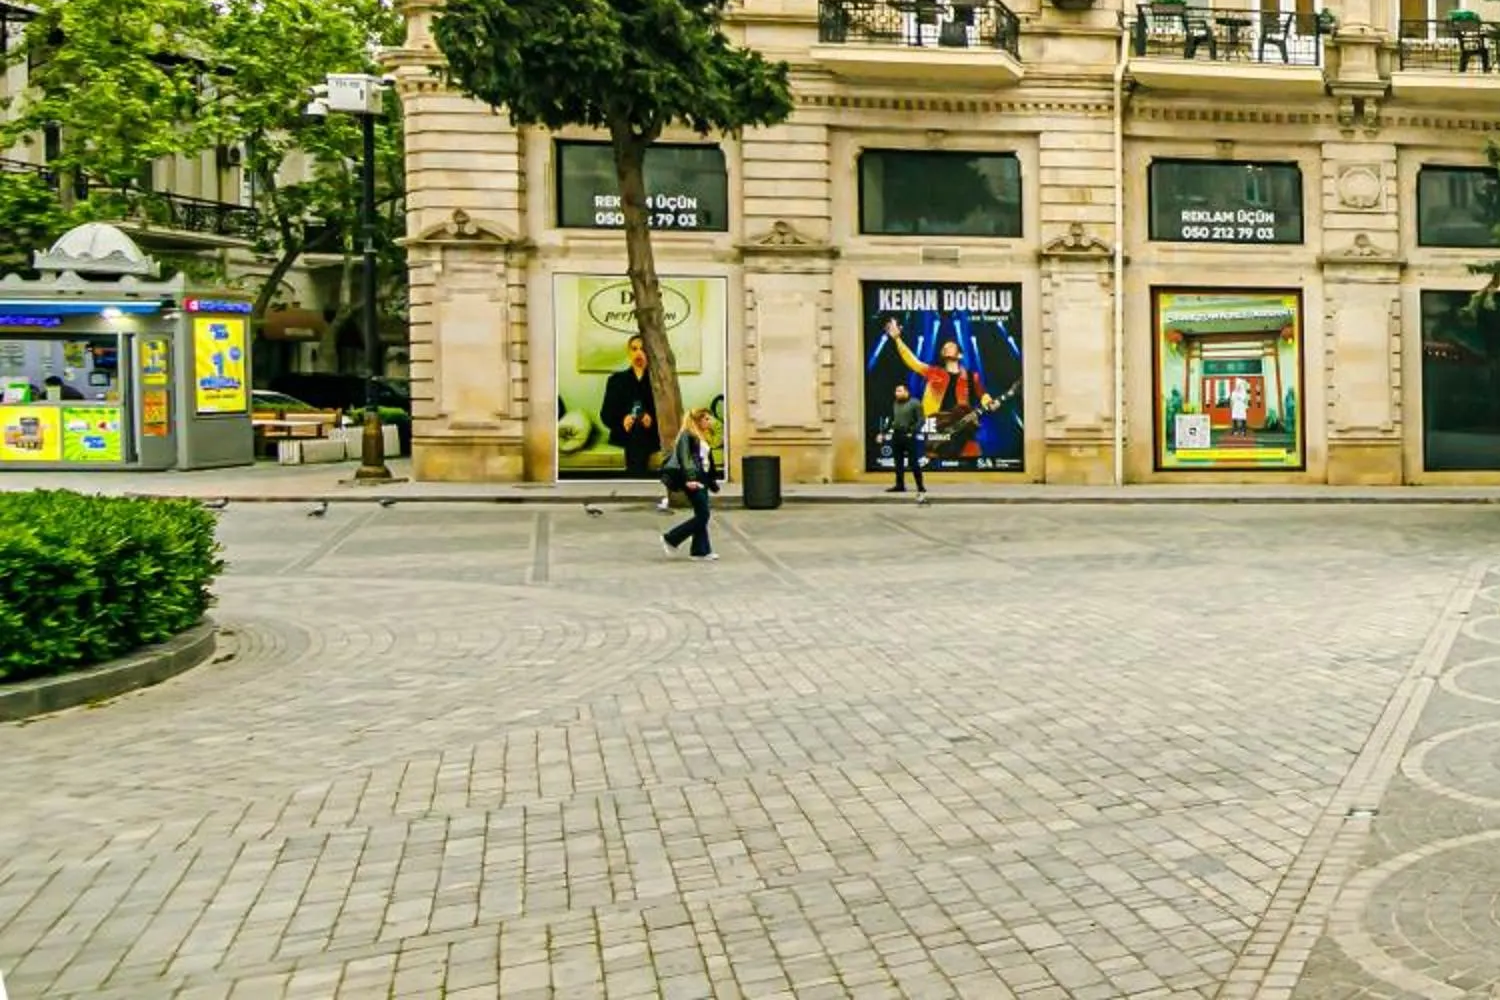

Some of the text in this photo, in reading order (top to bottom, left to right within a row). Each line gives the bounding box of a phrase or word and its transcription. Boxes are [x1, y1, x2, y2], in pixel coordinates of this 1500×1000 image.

[656, 194, 698, 211] ÜÇÜN
[656, 213, 675, 226] 79
[677, 213, 697, 227] 03
[1181, 209, 1275, 226] REKLAM ÜÇÜN
[1181, 225, 1275, 239] 050 212 79 03
[879, 285, 1013, 313] KENAN DOĞULU
